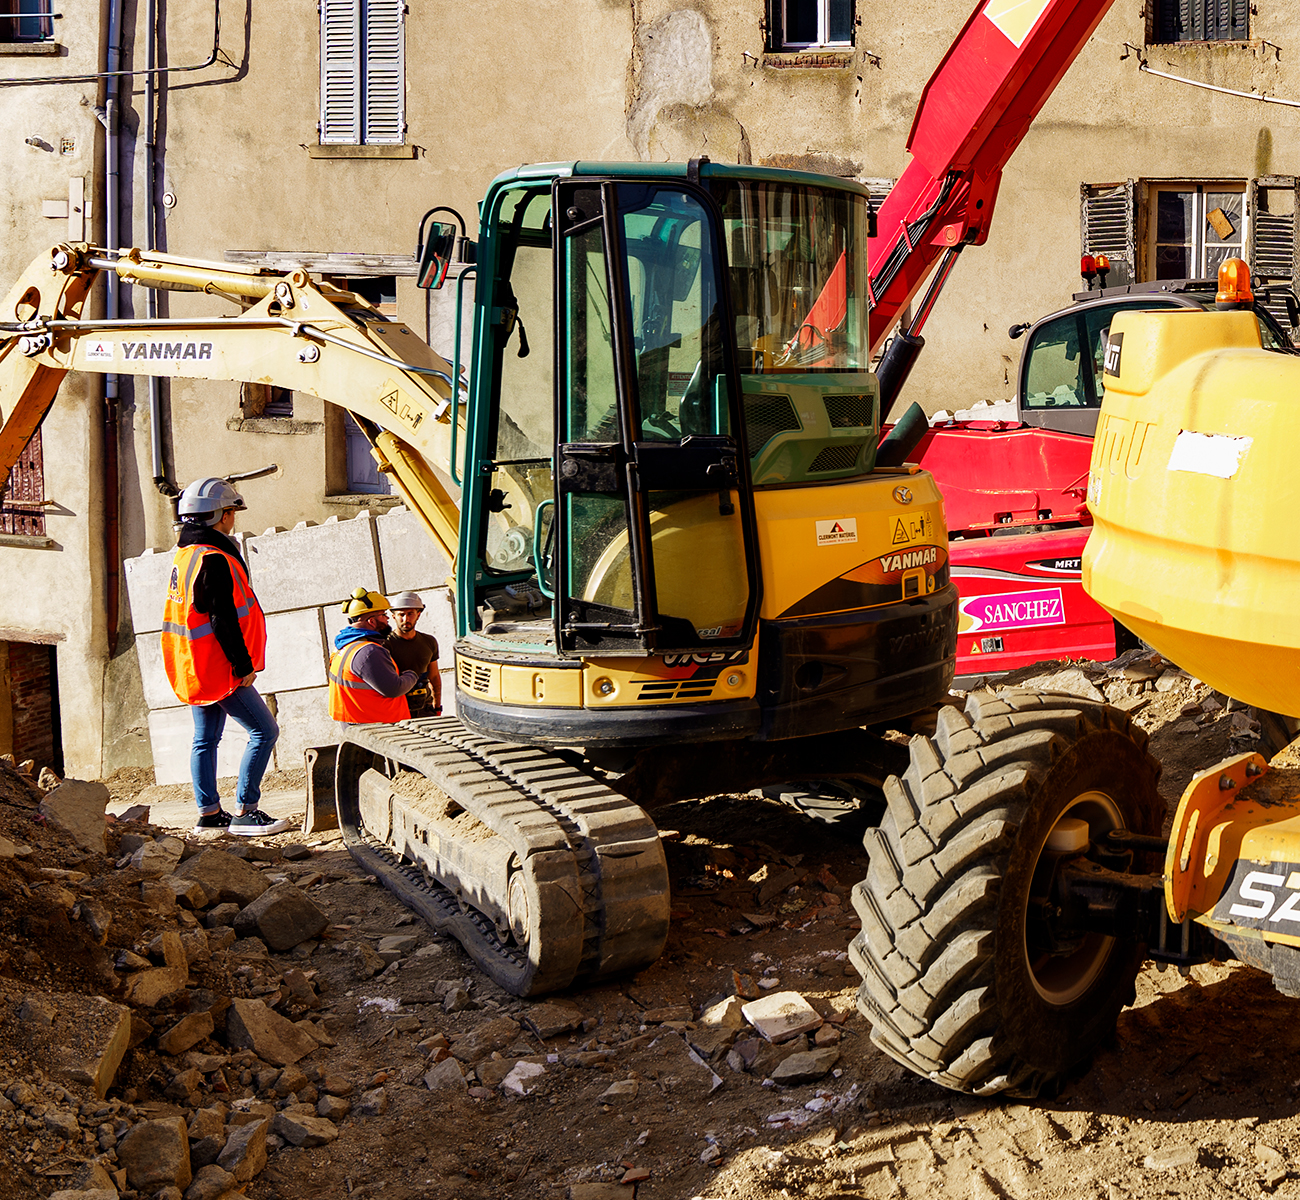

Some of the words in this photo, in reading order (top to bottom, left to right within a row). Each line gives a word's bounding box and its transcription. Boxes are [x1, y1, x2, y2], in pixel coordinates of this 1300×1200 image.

[121, 342, 213, 360] YANMAR
[879, 546, 937, 573] YANMAR
[1054, 558, 1082, 569] MRT
[984, 598, 1060, 624] SANCHEZ
